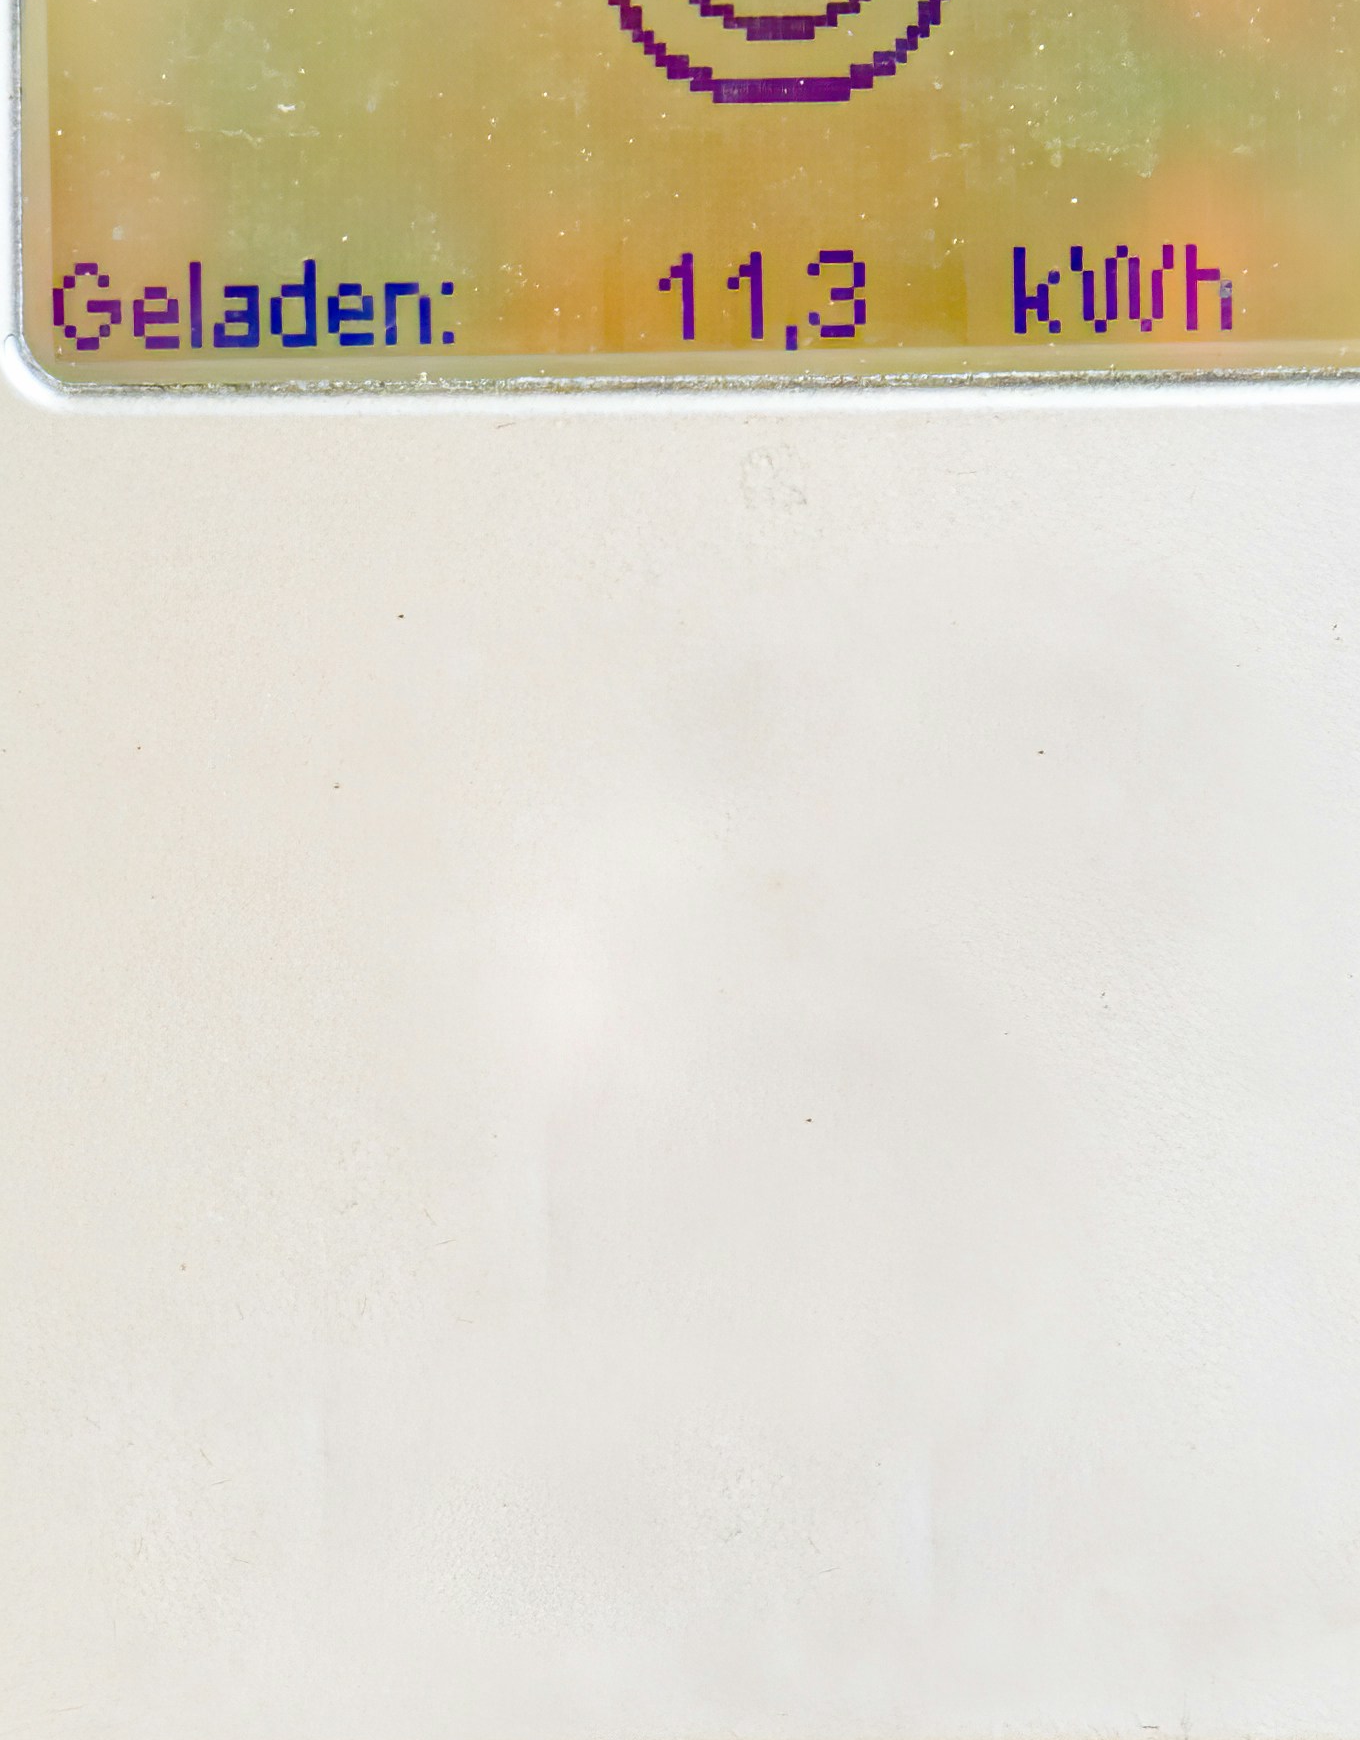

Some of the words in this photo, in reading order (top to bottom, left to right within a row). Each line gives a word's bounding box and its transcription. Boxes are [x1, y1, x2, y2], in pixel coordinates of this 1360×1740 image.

[52, 258, 455, 351] Geladen:
[658, 249, 866, 351] 11,3
[1013, 244, 1234, 334] kWh
